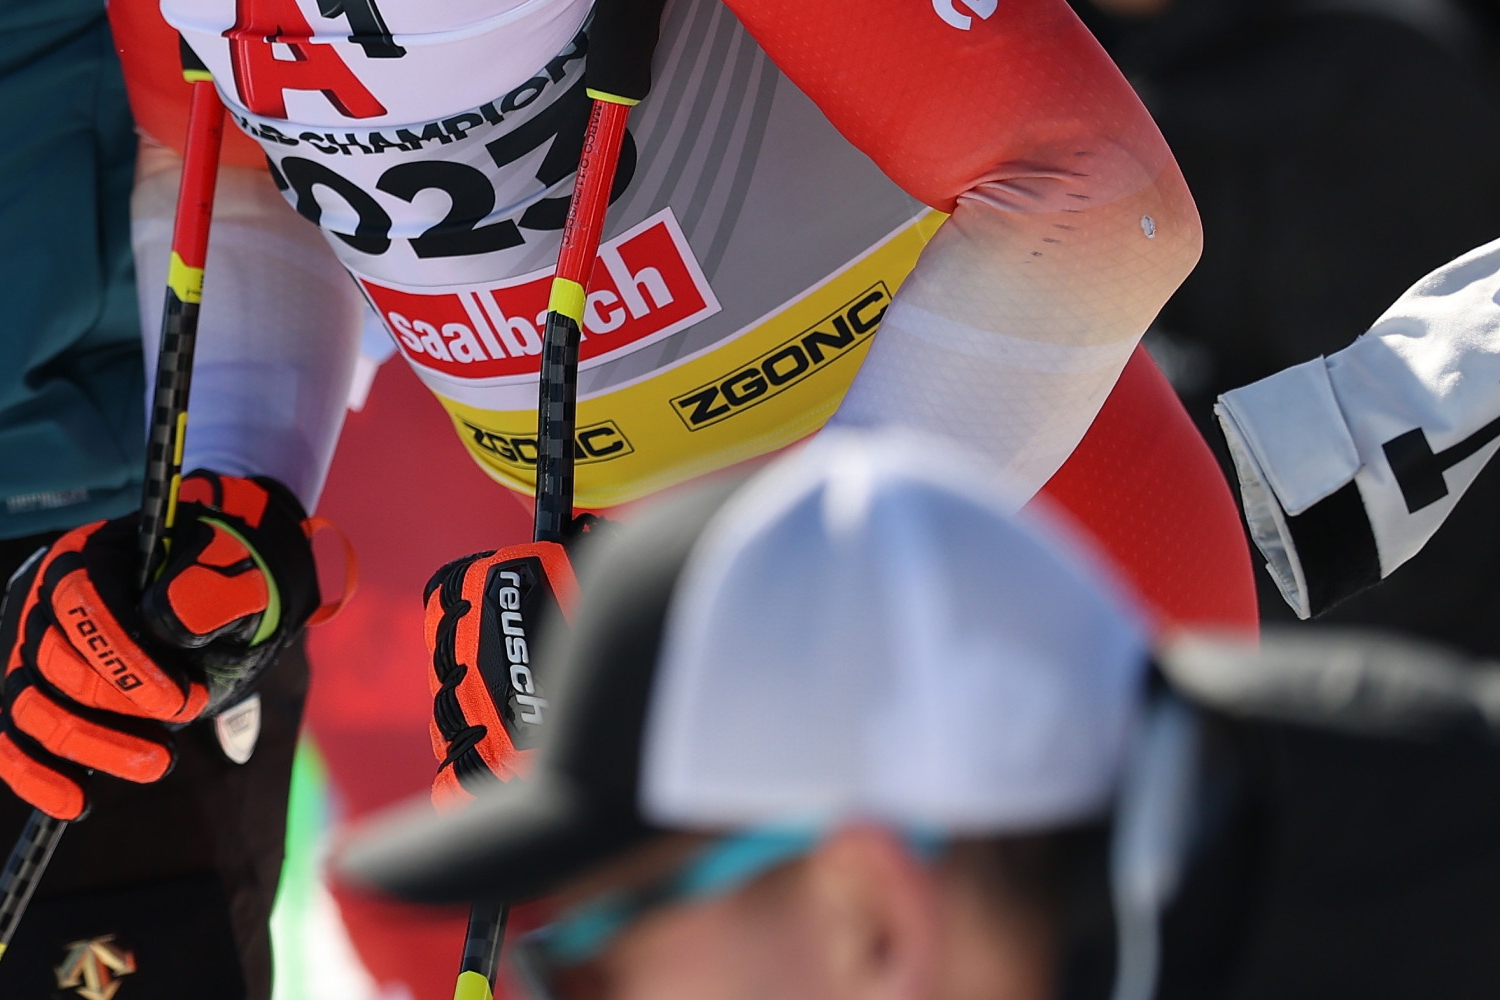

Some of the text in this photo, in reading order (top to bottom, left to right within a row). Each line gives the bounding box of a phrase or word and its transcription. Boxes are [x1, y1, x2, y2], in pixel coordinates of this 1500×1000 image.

[265, 72, 637, 259] 023
[388, 252, 674, 363] saalbch
[678, 291, 889, 425] ZGONC
[463, 422, 624, 464] ZGOC
[68, 606, 143, 692] racing
[500, 571, 549, 726] reusch
